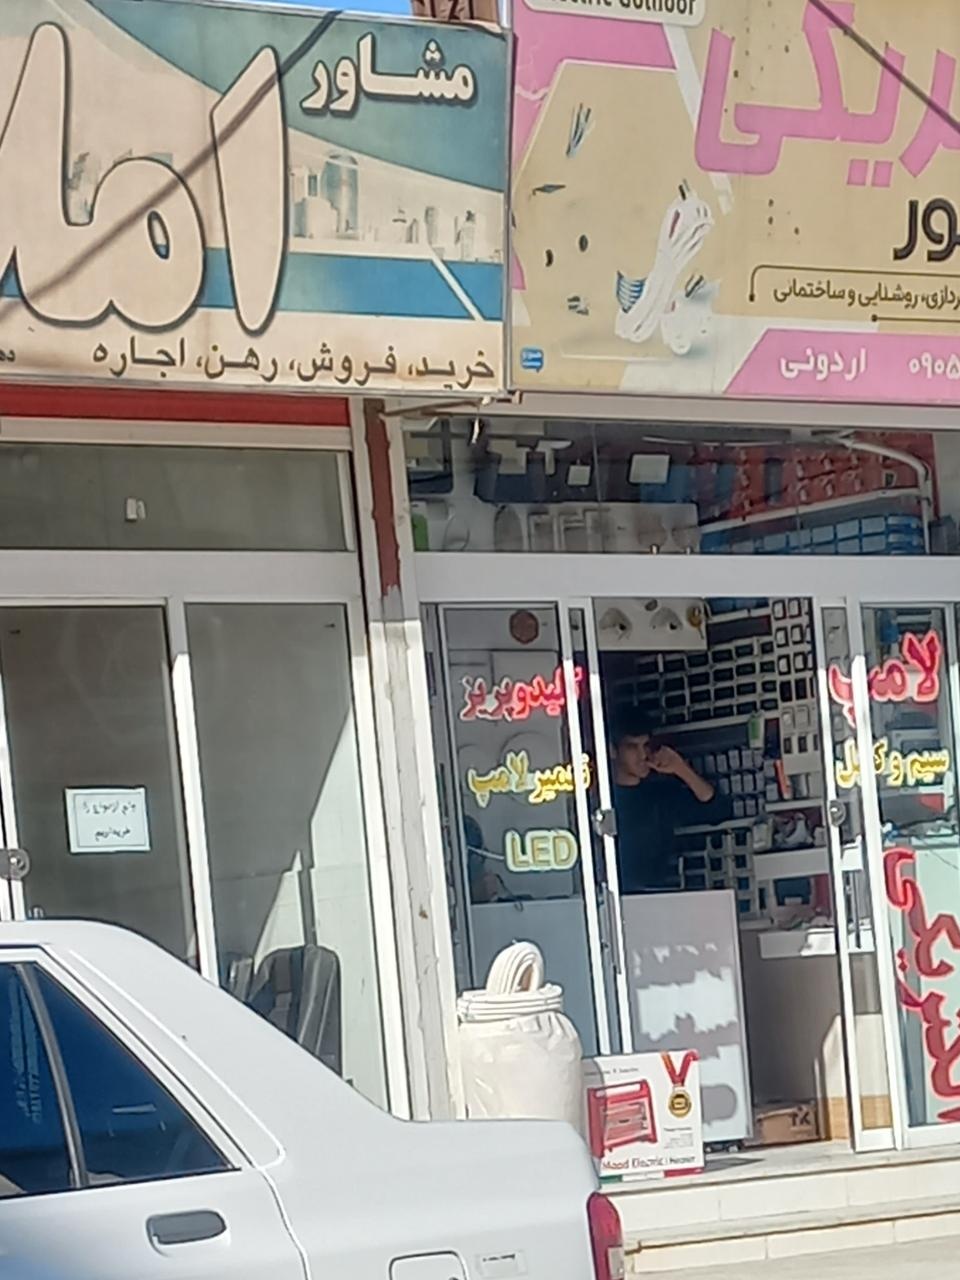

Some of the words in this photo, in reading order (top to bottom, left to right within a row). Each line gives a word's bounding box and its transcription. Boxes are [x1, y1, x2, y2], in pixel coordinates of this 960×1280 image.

[301, 32, 476, 113] مشاور
[773, 278, 847, 303] ساختمانی
[92, 336, 186, 379] اجاره
[907, 748, 949, 786] سیم
[505, 829, 577, 872] LED
